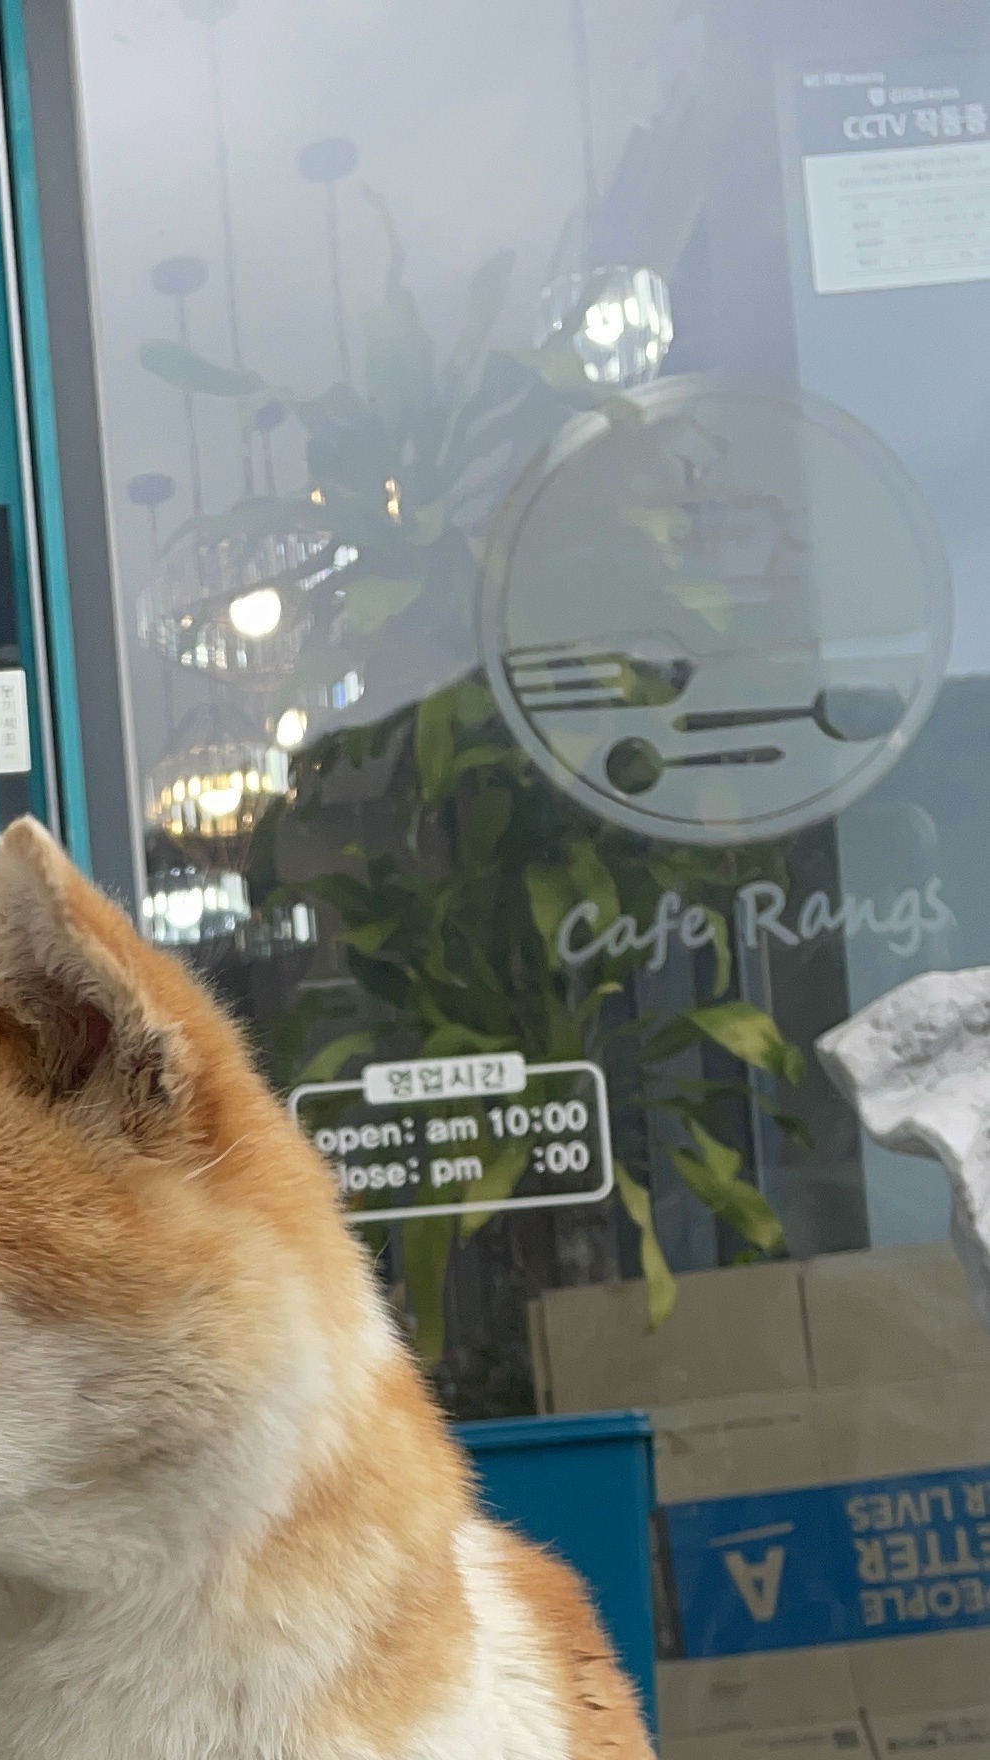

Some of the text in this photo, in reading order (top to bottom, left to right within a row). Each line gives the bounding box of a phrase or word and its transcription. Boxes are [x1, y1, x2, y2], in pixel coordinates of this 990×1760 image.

[843, 102, 989, 140] CCTV 작동중
[557, 875, 958, 972] Cafe Rangs
[387, 1060, 506, 1099] 영업시간
[314, 1099, 589, 1155] open: am 10:00
[340, 1156, 421, 1192] lose:
[430, 1155, 484, 1188] pm
[846, 1485, 954, 1533] LIVES
[858, 1577, 990, 1627] EOPLE
